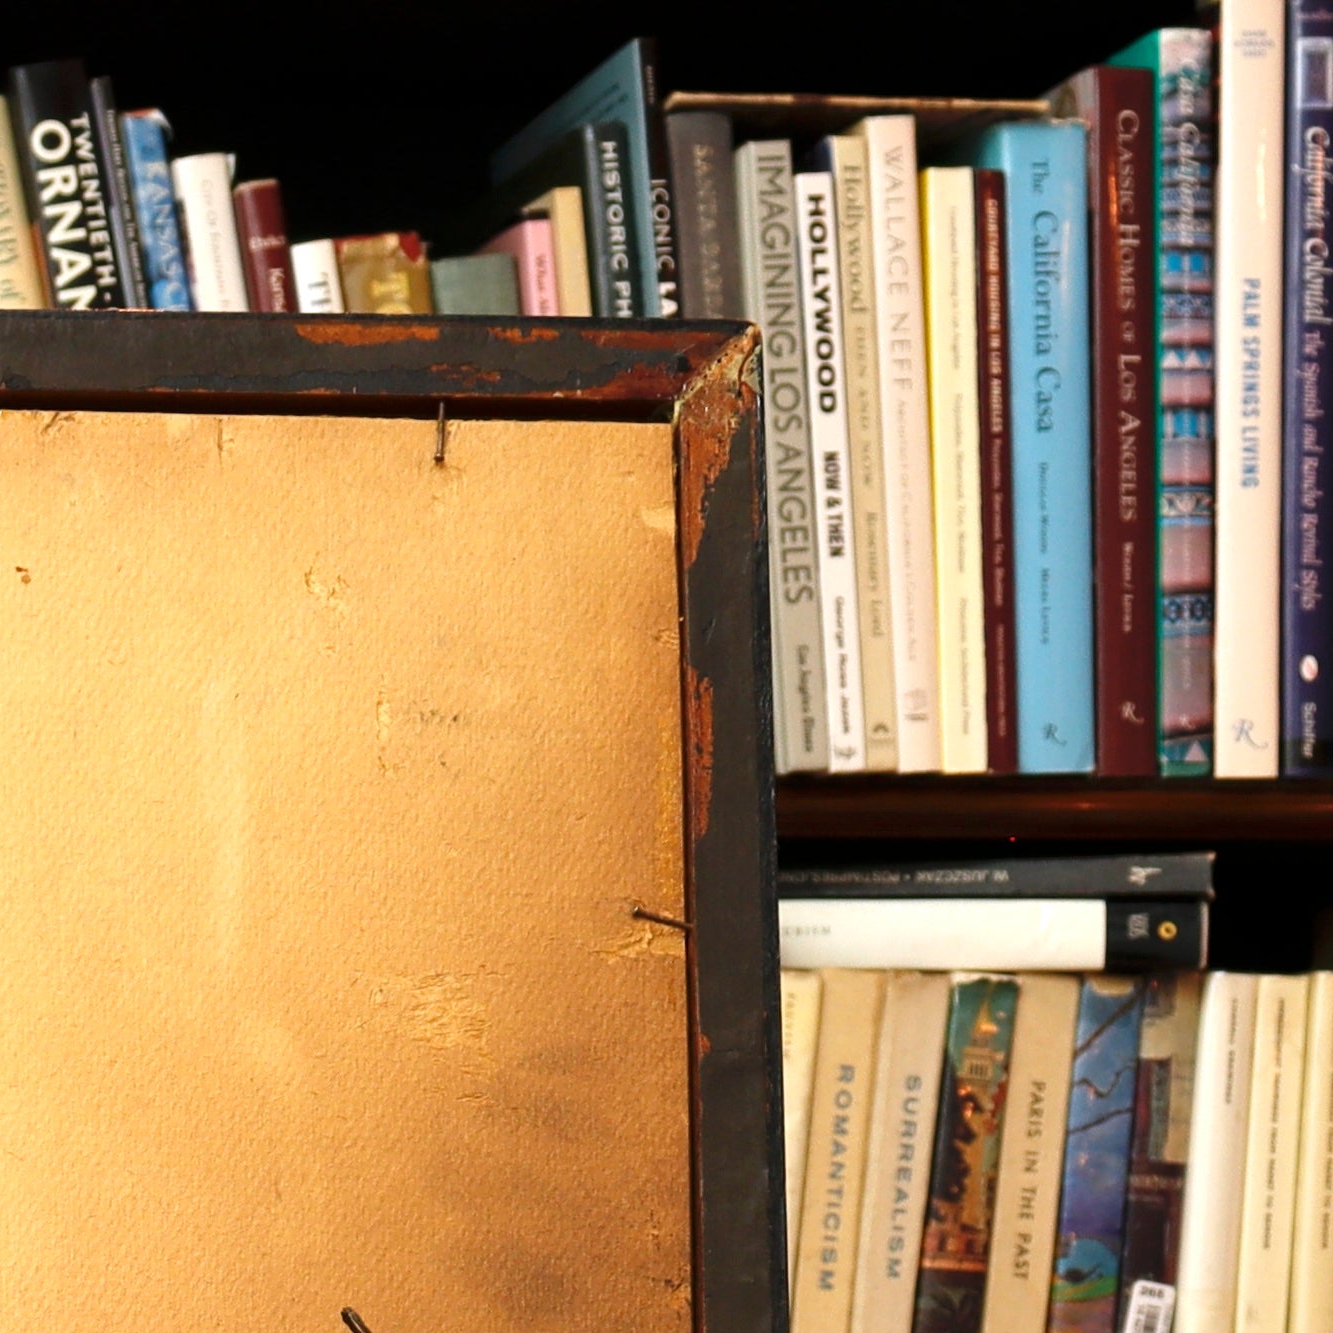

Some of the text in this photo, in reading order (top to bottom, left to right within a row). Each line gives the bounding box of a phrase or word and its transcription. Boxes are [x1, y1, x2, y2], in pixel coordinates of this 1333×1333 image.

[70, 112, 119, 289] TWENTIETH
[600, 140, 629, 272] HISTORIC
[1030, 157, 1052, 195] The
[1116, 108, 1141, 216] CLASSIC
[1299, 125, 1333, 231] California
[649, 179, 680, 317] ICONIC LA
[807, 194, 837, 414] HOLLYWOOD
[840, 164, 870, 315] Hollywood
[883, 145, 914, 390] WALLACE NEFF
[1032, 210, 1062, 357] California
[1117, 223, 1142, 311] HOMES
[1303, 237, 1333, 326] Colonial
[757, 154, 815, 605] IMAGINING LOS ANGELES
[1034, 365, 1063, 434] Casa
[1118, 353, 1142, 404] LOS
[1242, 277, 1262, 489] PALM SPRINGS LIVING
[1298, 361, 1324, 418] Spanish
[823, 451, 842, 490] NOW
[1119, 410, 1142, 522] ANGELES
[827, 513, 846, 557] THEN
[818, 1063, 856, 1292] ROMANTICISM
[886, 1073, 923, 1280] SURREALISM
[1012, 1079, 1048, 1281] PARIS IN THE PAST
